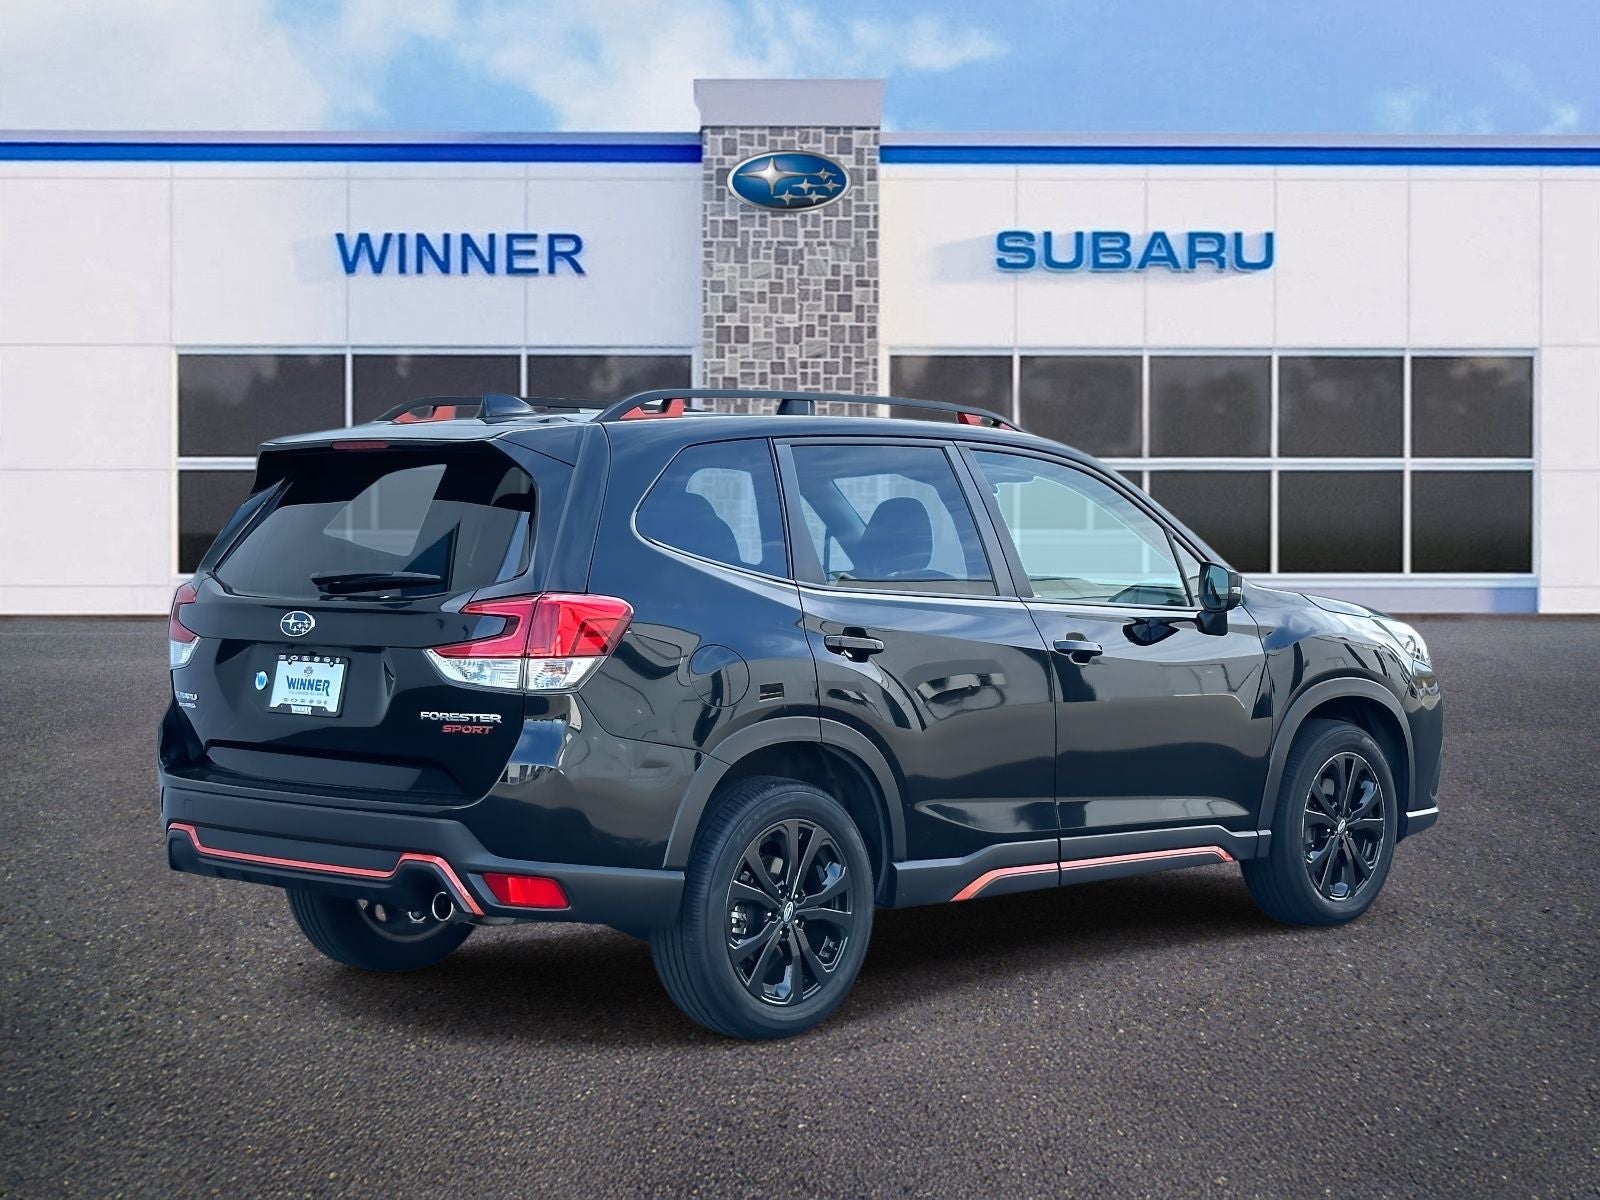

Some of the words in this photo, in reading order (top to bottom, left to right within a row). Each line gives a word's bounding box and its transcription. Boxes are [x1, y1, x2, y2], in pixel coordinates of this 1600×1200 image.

[335, 232, 586, 275] WINNER
[996, 230, 1275, 271] SUBARU
[286, 675, 331, 697] WINNER
[420, 711, 502, 723] FORESTER
[441, 724, 494, 735] SPORT
